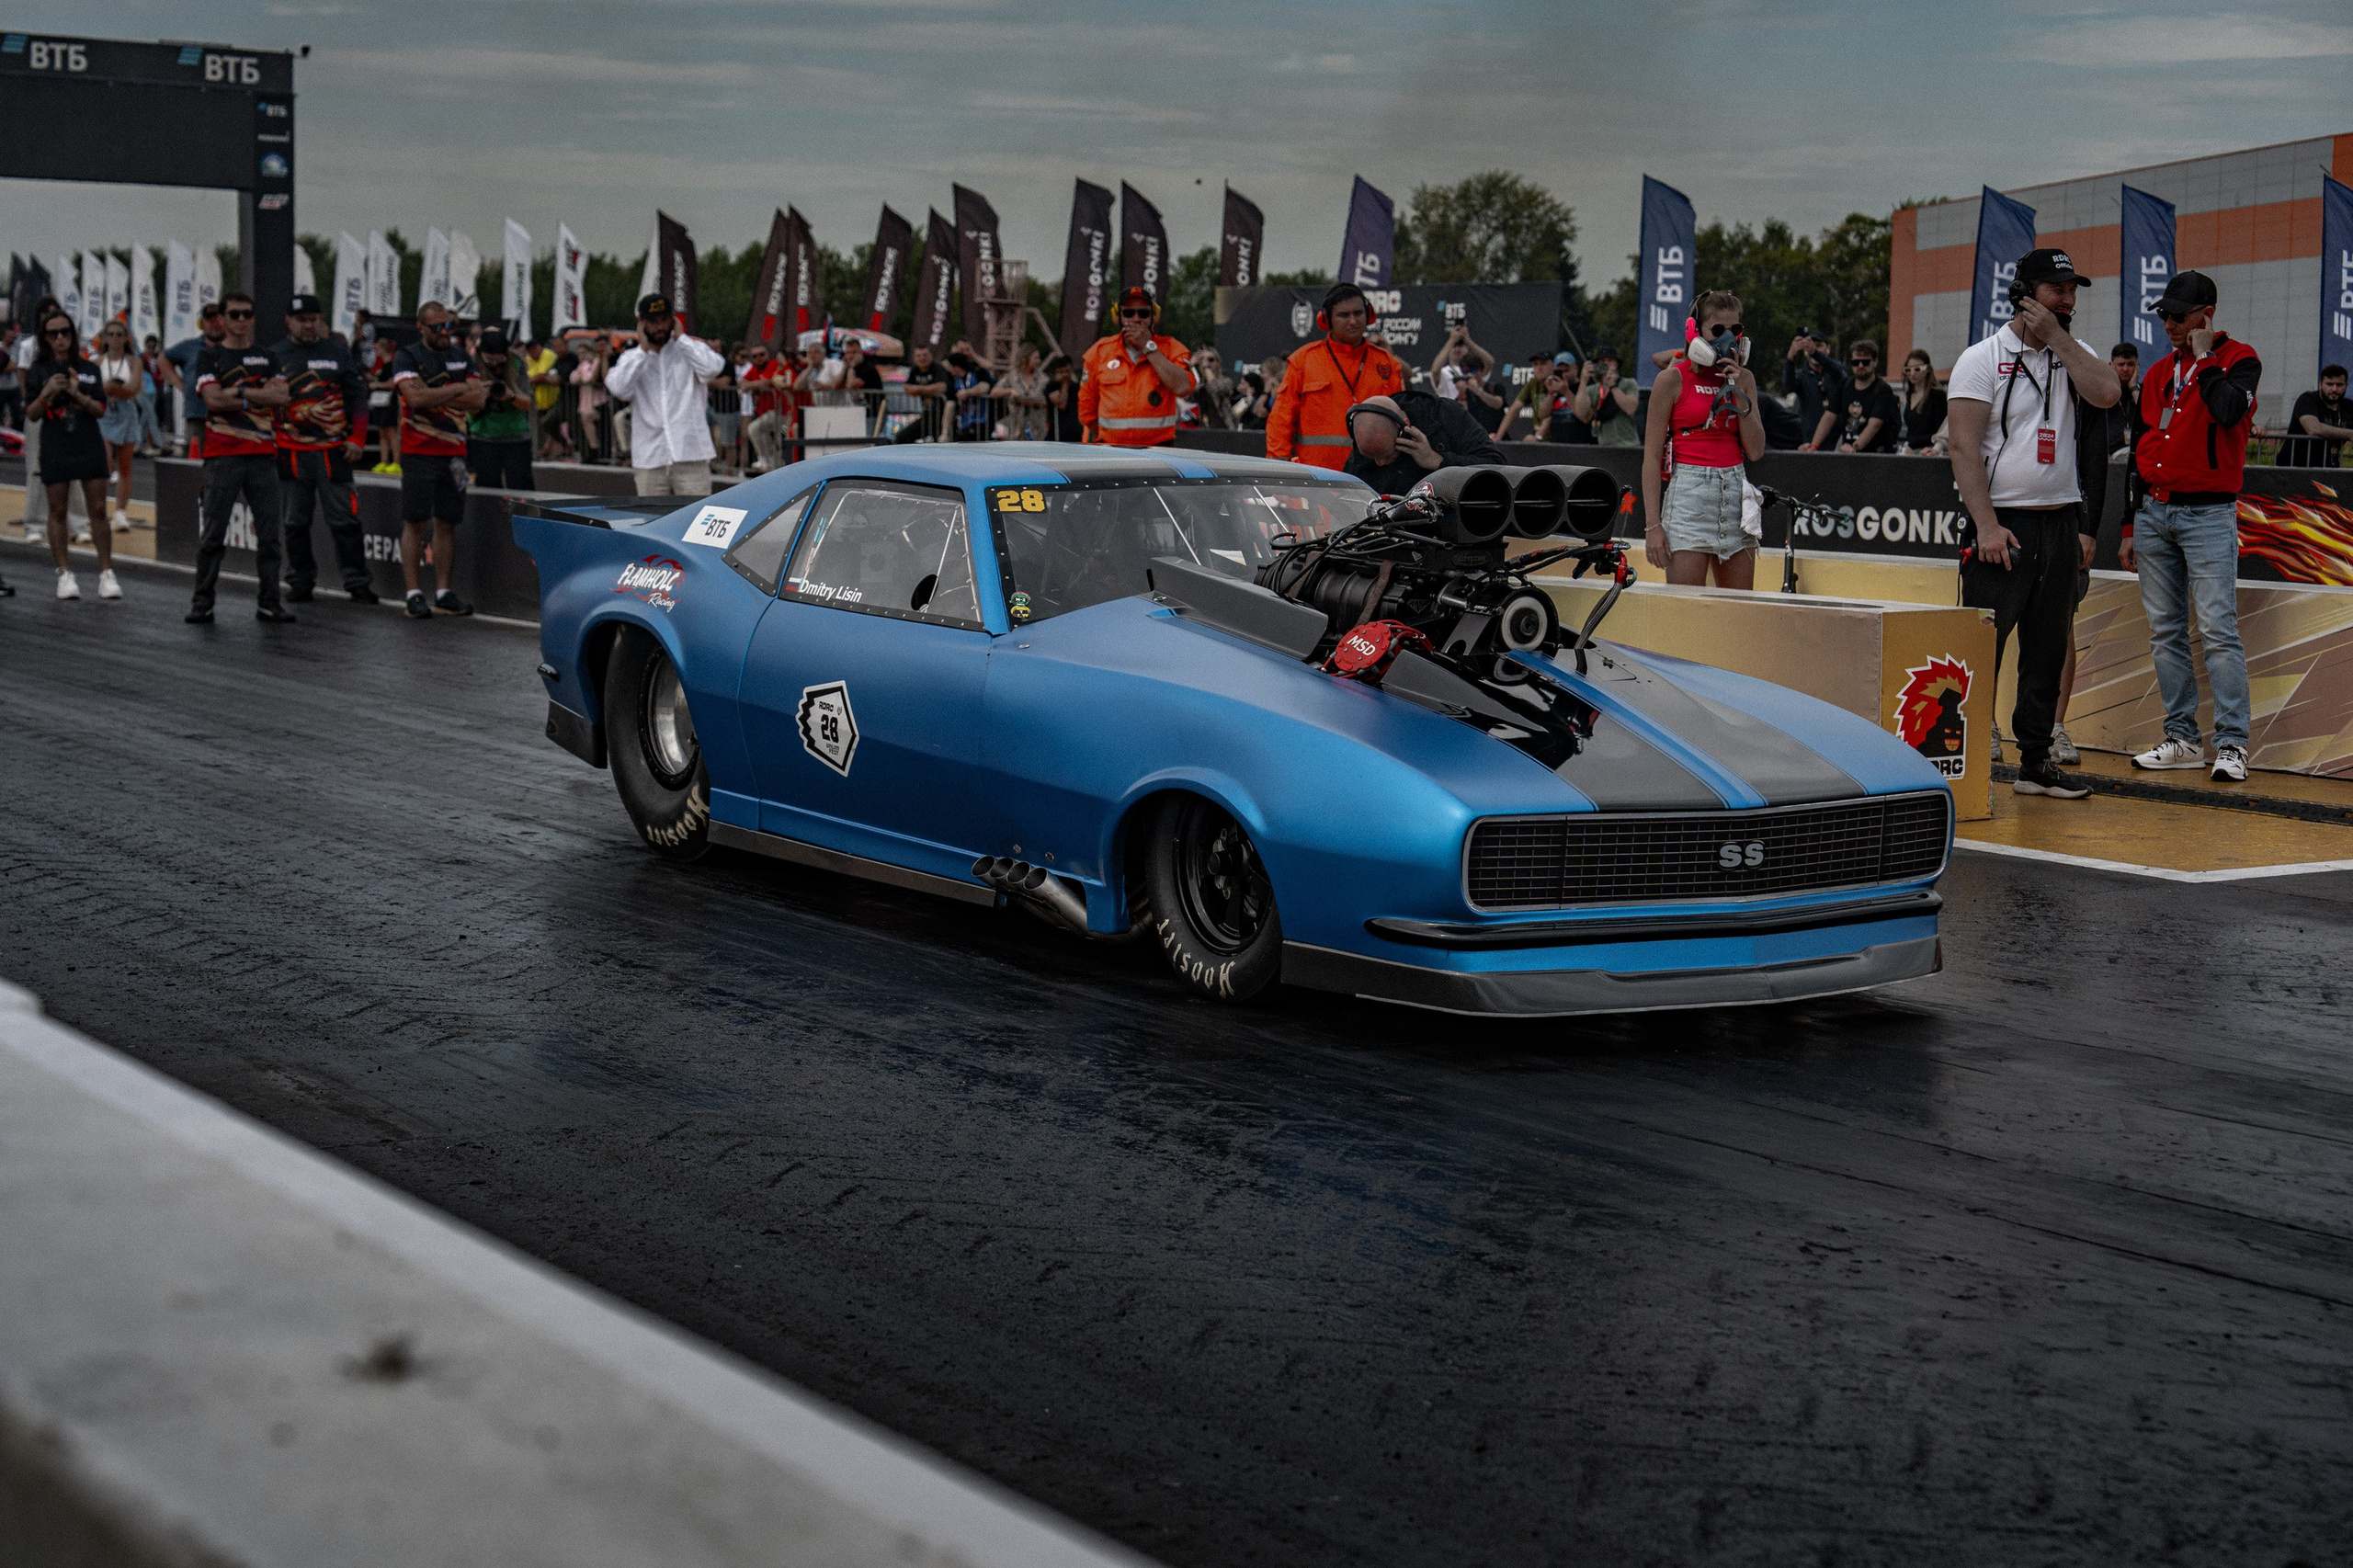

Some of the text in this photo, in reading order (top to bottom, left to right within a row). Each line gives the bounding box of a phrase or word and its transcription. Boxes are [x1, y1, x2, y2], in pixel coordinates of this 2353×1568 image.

[29, 41, 88, 72] ВТБ
[204, 54, 261, 85] ВТБ
[267, 105, 288, 117] ВТБ
[1085, 231, 1105, 321] ROSGONKI
[1354, 251, 1381, 288] ТБ
[1656, 245, 1684, 303] ВТБ
[1990, 261, 2019, 319] ВТБ
[1445, 302, 1467, 320] ВТБ
[1694, 384, 1720, 395] RDR
[996, 490, 1046, 512] 28
[705, 518, 731, 539] ВТБ
[648, 592, 676, 613] Racing
[798, 579, 862, 603] Dmitry Lisin
[1347, 634, 1376, 656] MSD
[821, 713, 839, 744] 28
[1717, 840, 1766, 869] SS
